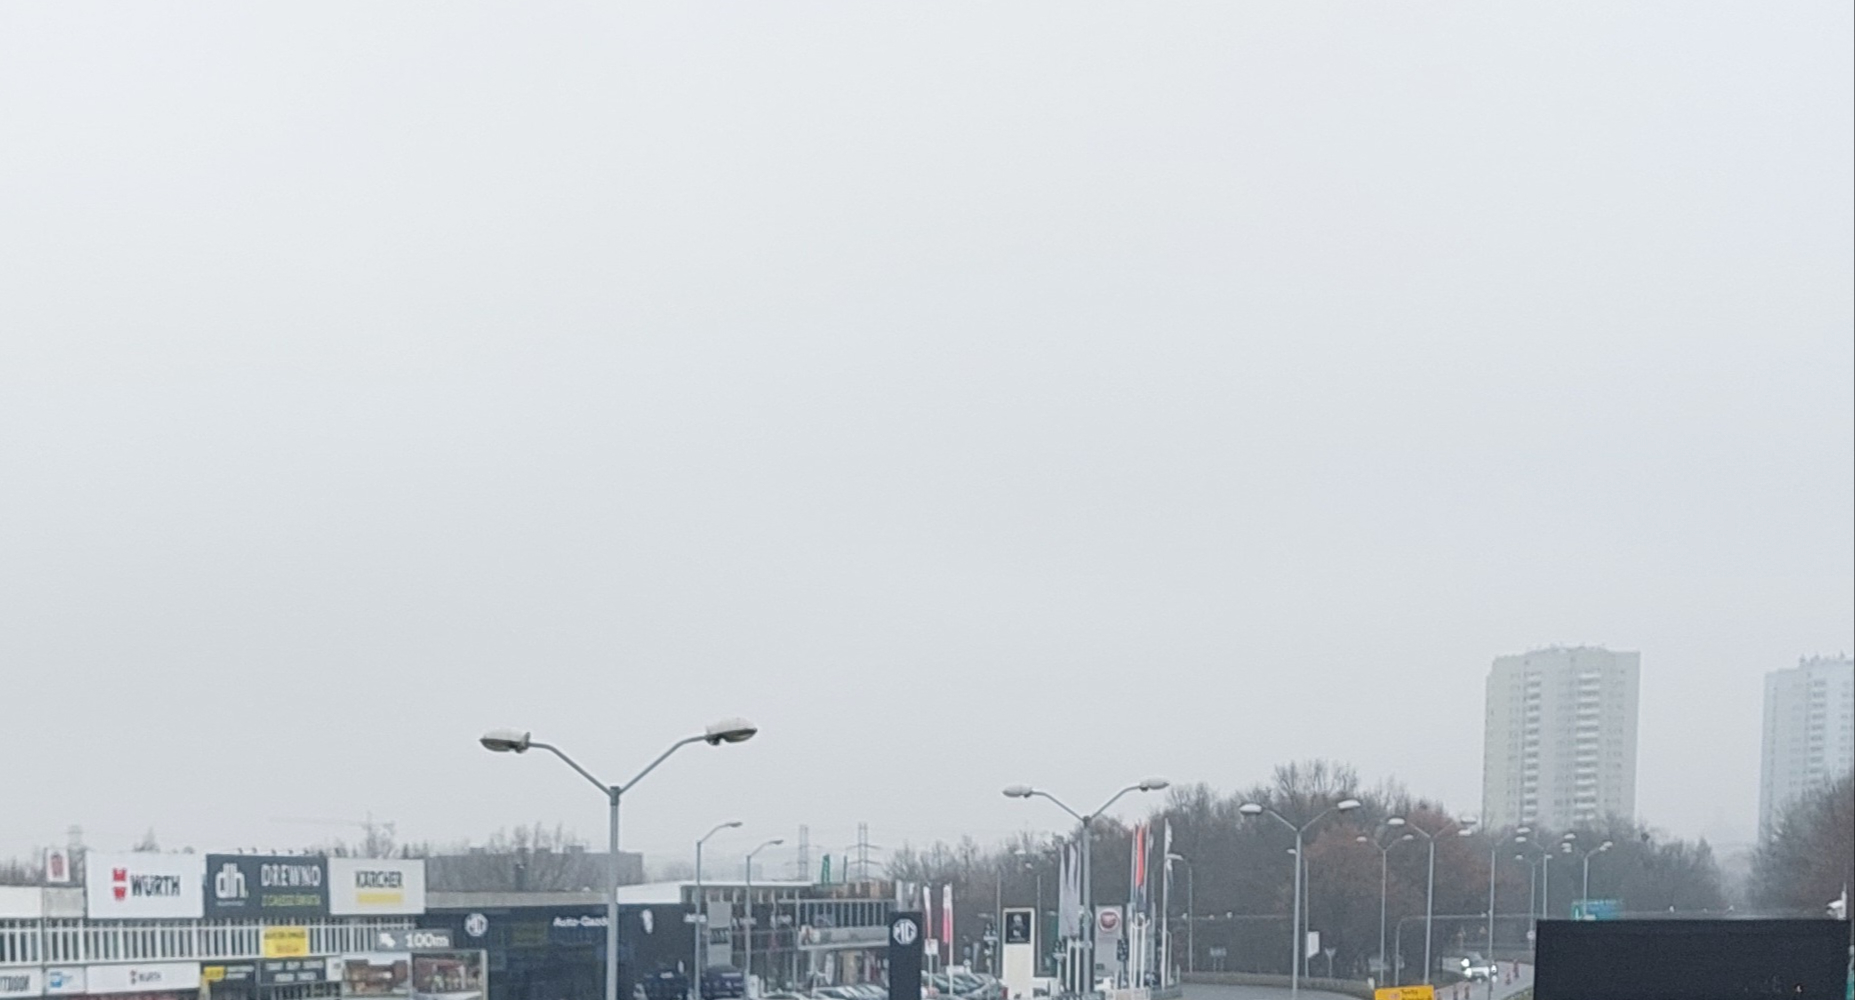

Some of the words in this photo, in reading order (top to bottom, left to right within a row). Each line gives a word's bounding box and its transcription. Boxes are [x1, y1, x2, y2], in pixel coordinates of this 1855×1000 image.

[261, 864, 322, 887] DREWNO
[406, 933, 449, 948] 100m
[893, 919, 918, 944] MG
